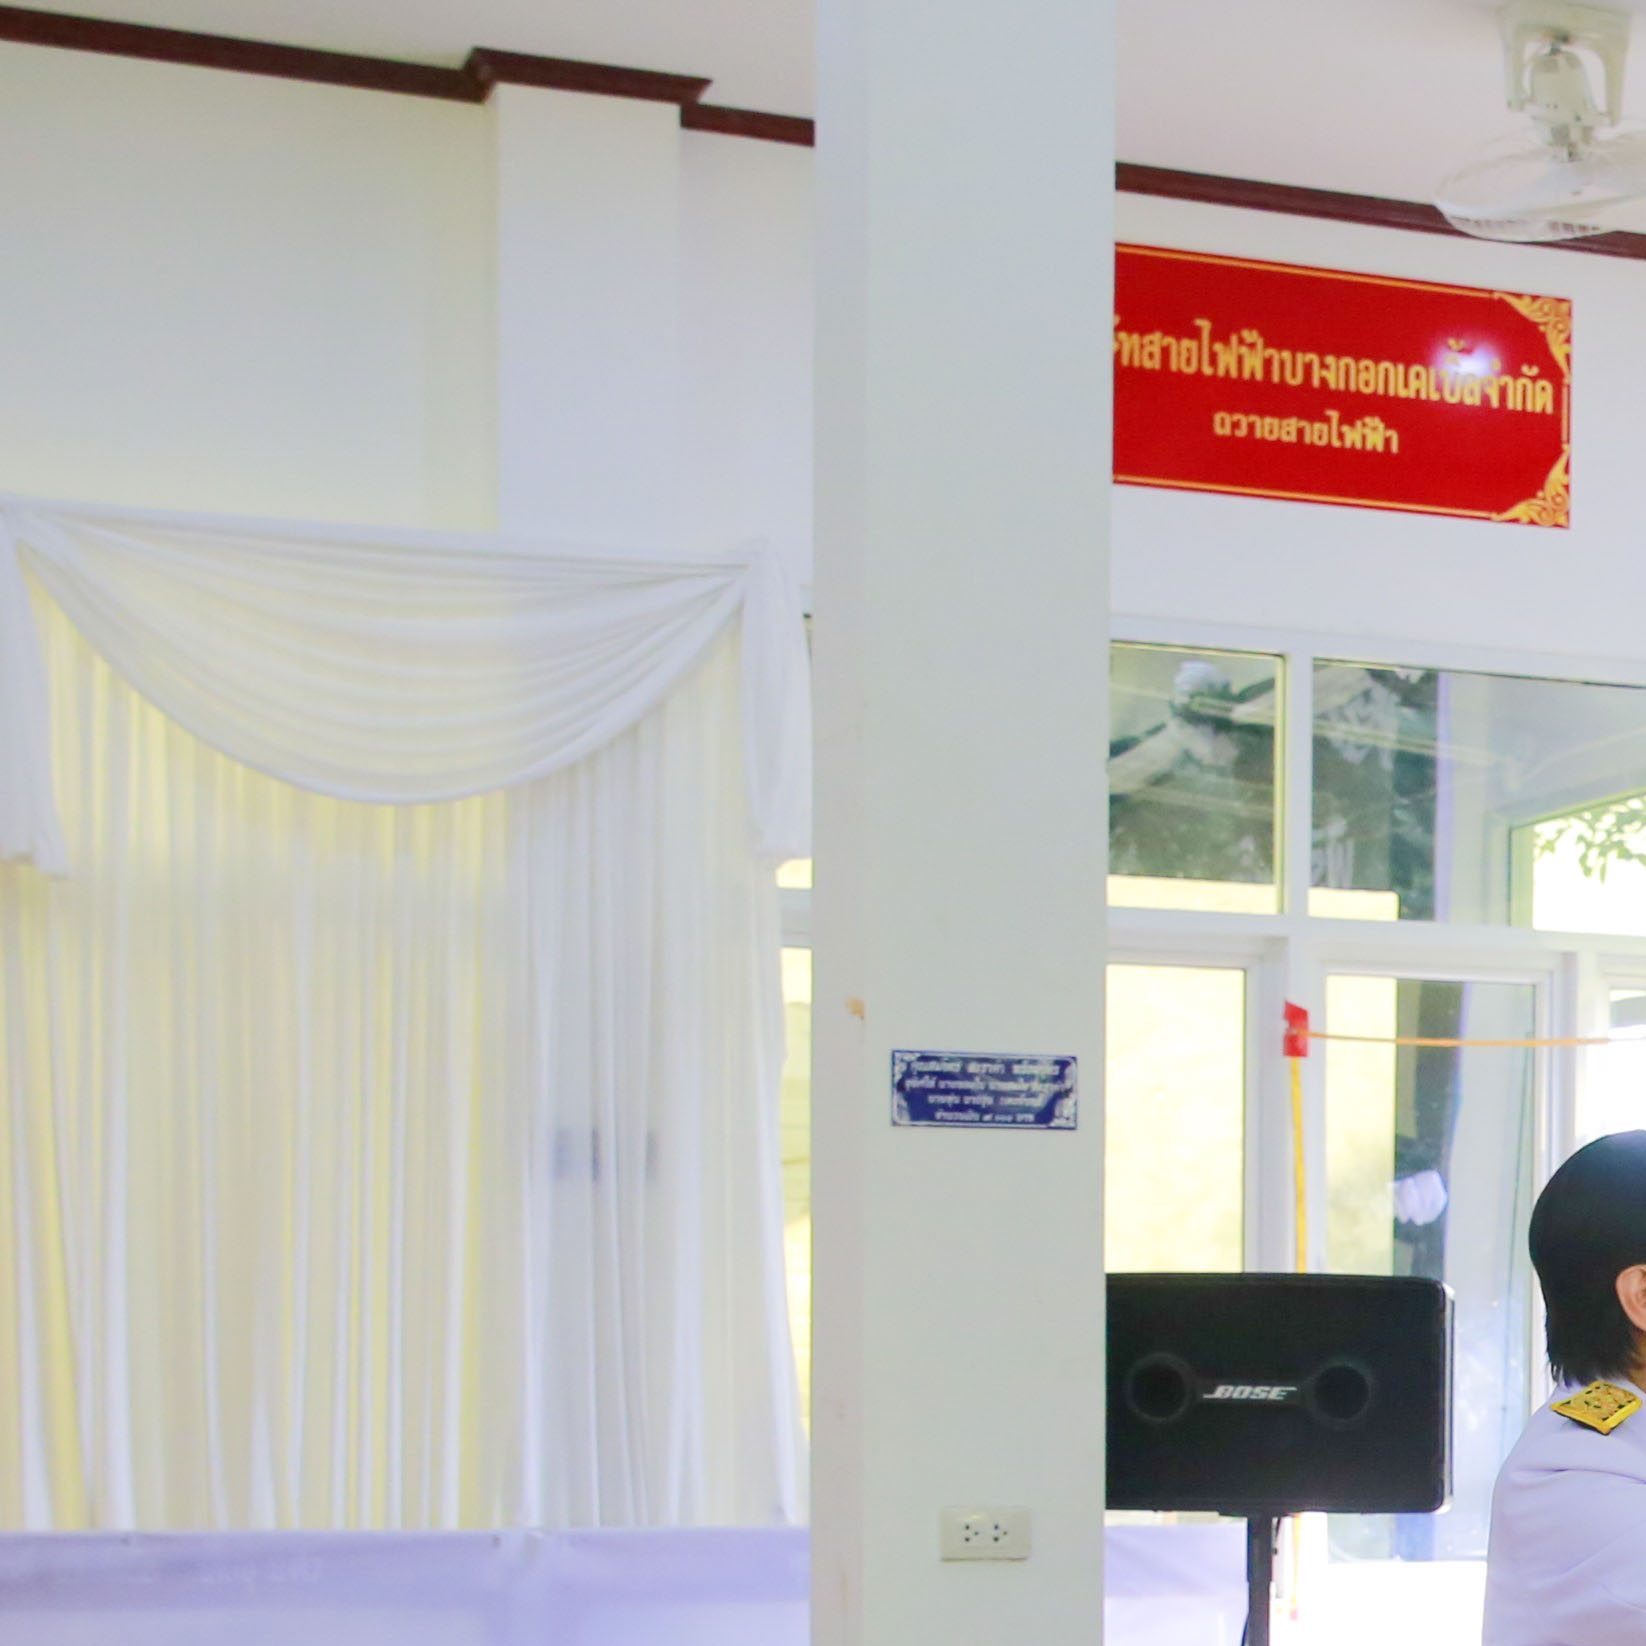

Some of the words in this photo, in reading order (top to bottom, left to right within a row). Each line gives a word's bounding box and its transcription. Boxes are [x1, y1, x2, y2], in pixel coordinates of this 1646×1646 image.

[1114, 314, 1554, 415] ทสายไฟฟ้าบางกอกเคเบิ้ลจำกัด
[1213, 408, 1400, 455] ถวายสายไฟฟ้า
[1203, 1384, 1298, 1401] BOSE
